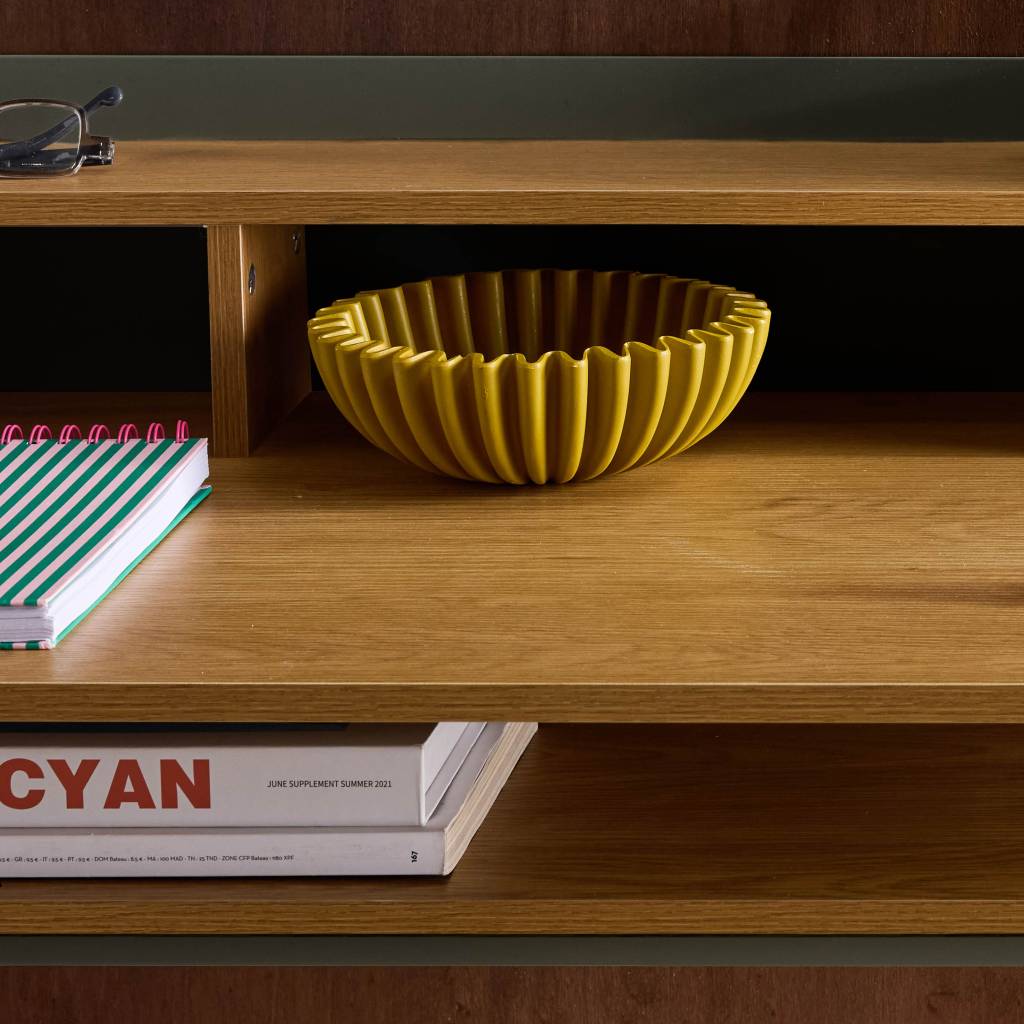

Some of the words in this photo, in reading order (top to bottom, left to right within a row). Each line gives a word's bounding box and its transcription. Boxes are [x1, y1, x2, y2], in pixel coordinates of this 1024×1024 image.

[0, 758, 211, 810] CYAN
[267, 780, 288, 788] JUNE
[289, 780, 339, 788] SUPPLEMENT
[340, 780, 374, 788] SUMMER
[375, 780, 392, 788] 2021
